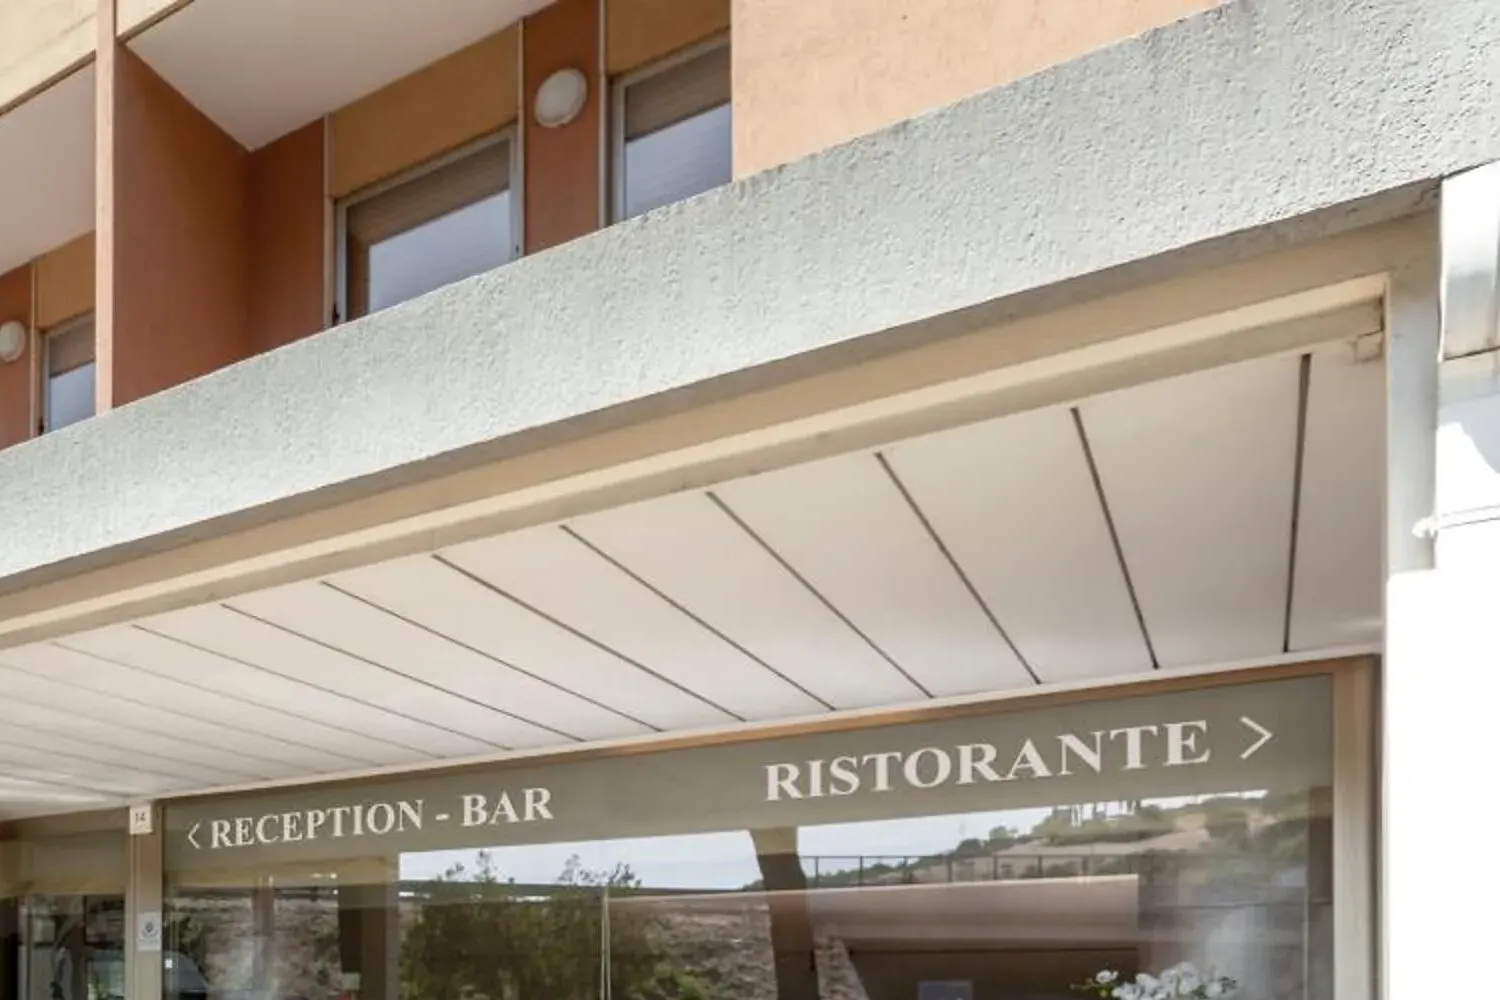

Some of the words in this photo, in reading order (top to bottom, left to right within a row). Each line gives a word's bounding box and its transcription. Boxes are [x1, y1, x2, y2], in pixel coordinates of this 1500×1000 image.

[765, 719, 1210, 801] RISTORANTE
[210, 799, 424, 849] RECEPTION
[462, 787, 554, 828] BAR
